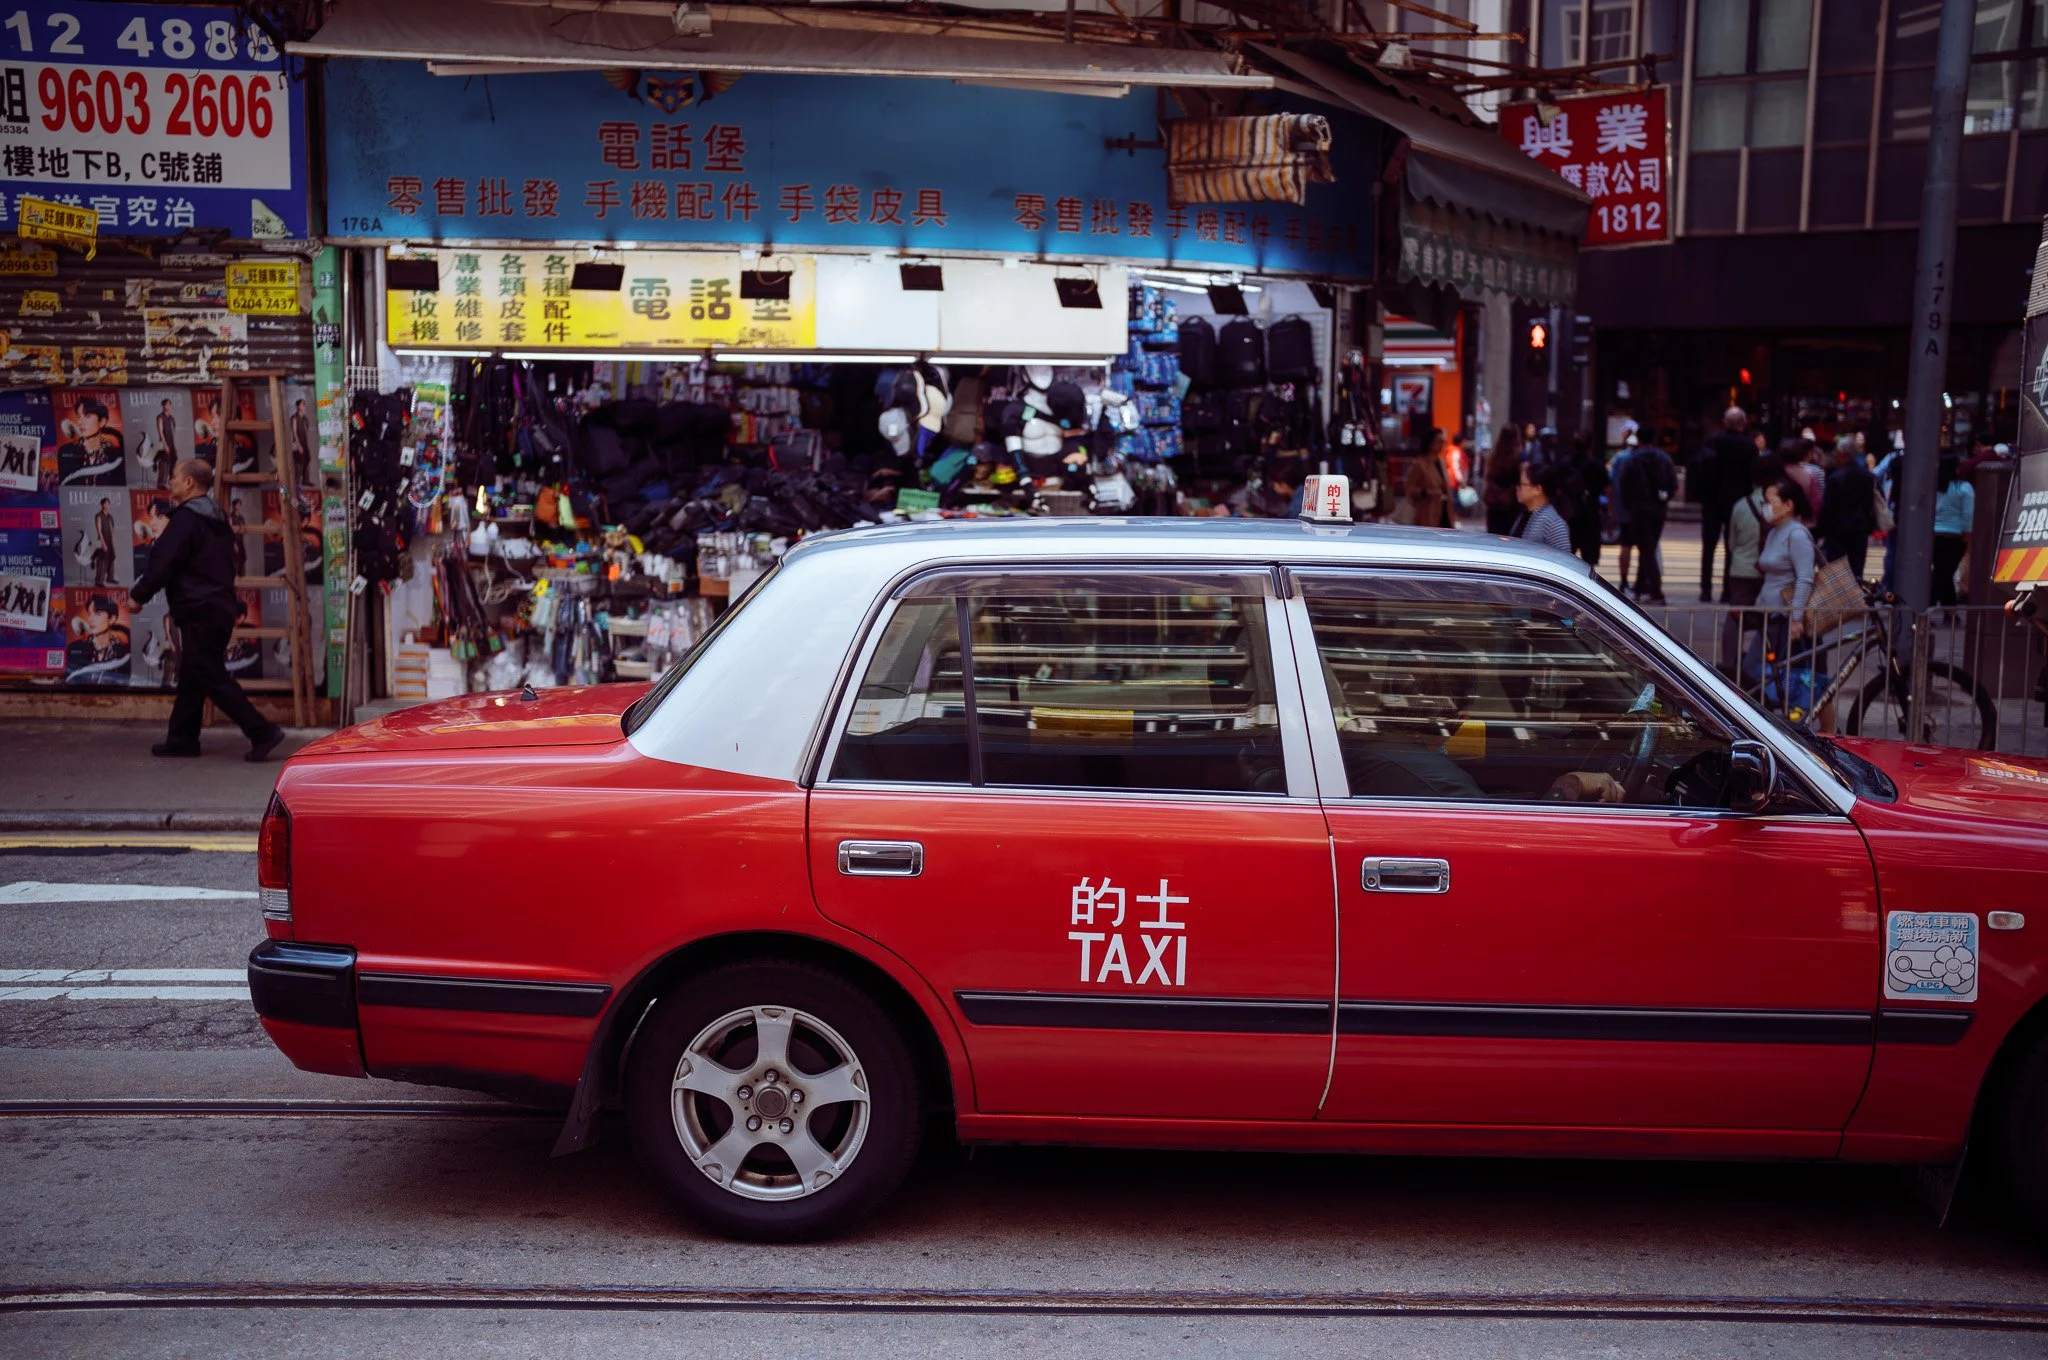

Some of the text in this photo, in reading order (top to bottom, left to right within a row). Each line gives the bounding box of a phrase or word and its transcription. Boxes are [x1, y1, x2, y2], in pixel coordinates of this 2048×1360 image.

[4, 10, 280, 63] 12 4888
[38, 67, 151, 136] 9603
[165, 72, 273, 138] 2606
[598, 121, 747, 173] 電話堡
[1519, 103, 1649, 159] 興業
[0, 192, 196, 229] 官究治
[340, 217, 383, 233] 176A
[387, 176, 949, 228] 零售批發 手機配件 手袋皮具
[1014, 192, 1154, 238] 零售批發
[1165, 203, 1271, 247] 手機配件
[1597, 202, 1662, 234] 1812
[455, 253, 483, 342] 專業維修
[499, 253, 527, 342] 各類皮套
[542, 253, 572, 342] 各種配件
[1924, 260, 1945, 357] 179A
[21, 424, 47, 436] PARTY
[1326, 484, 1341, 511] 的士
[8, 554, 34, 566] HOUSE
[32, 565, 57, 578] PARTY
[1071, 876, 1190, 930] 的士
[1896, 915, 1970, 930] 燃氣車輛
[1068, 931, 1188, 986] TAXI
[1896, 929, 1970, 944] 環境清新
[1920, 981, 1940, 989] LPG
